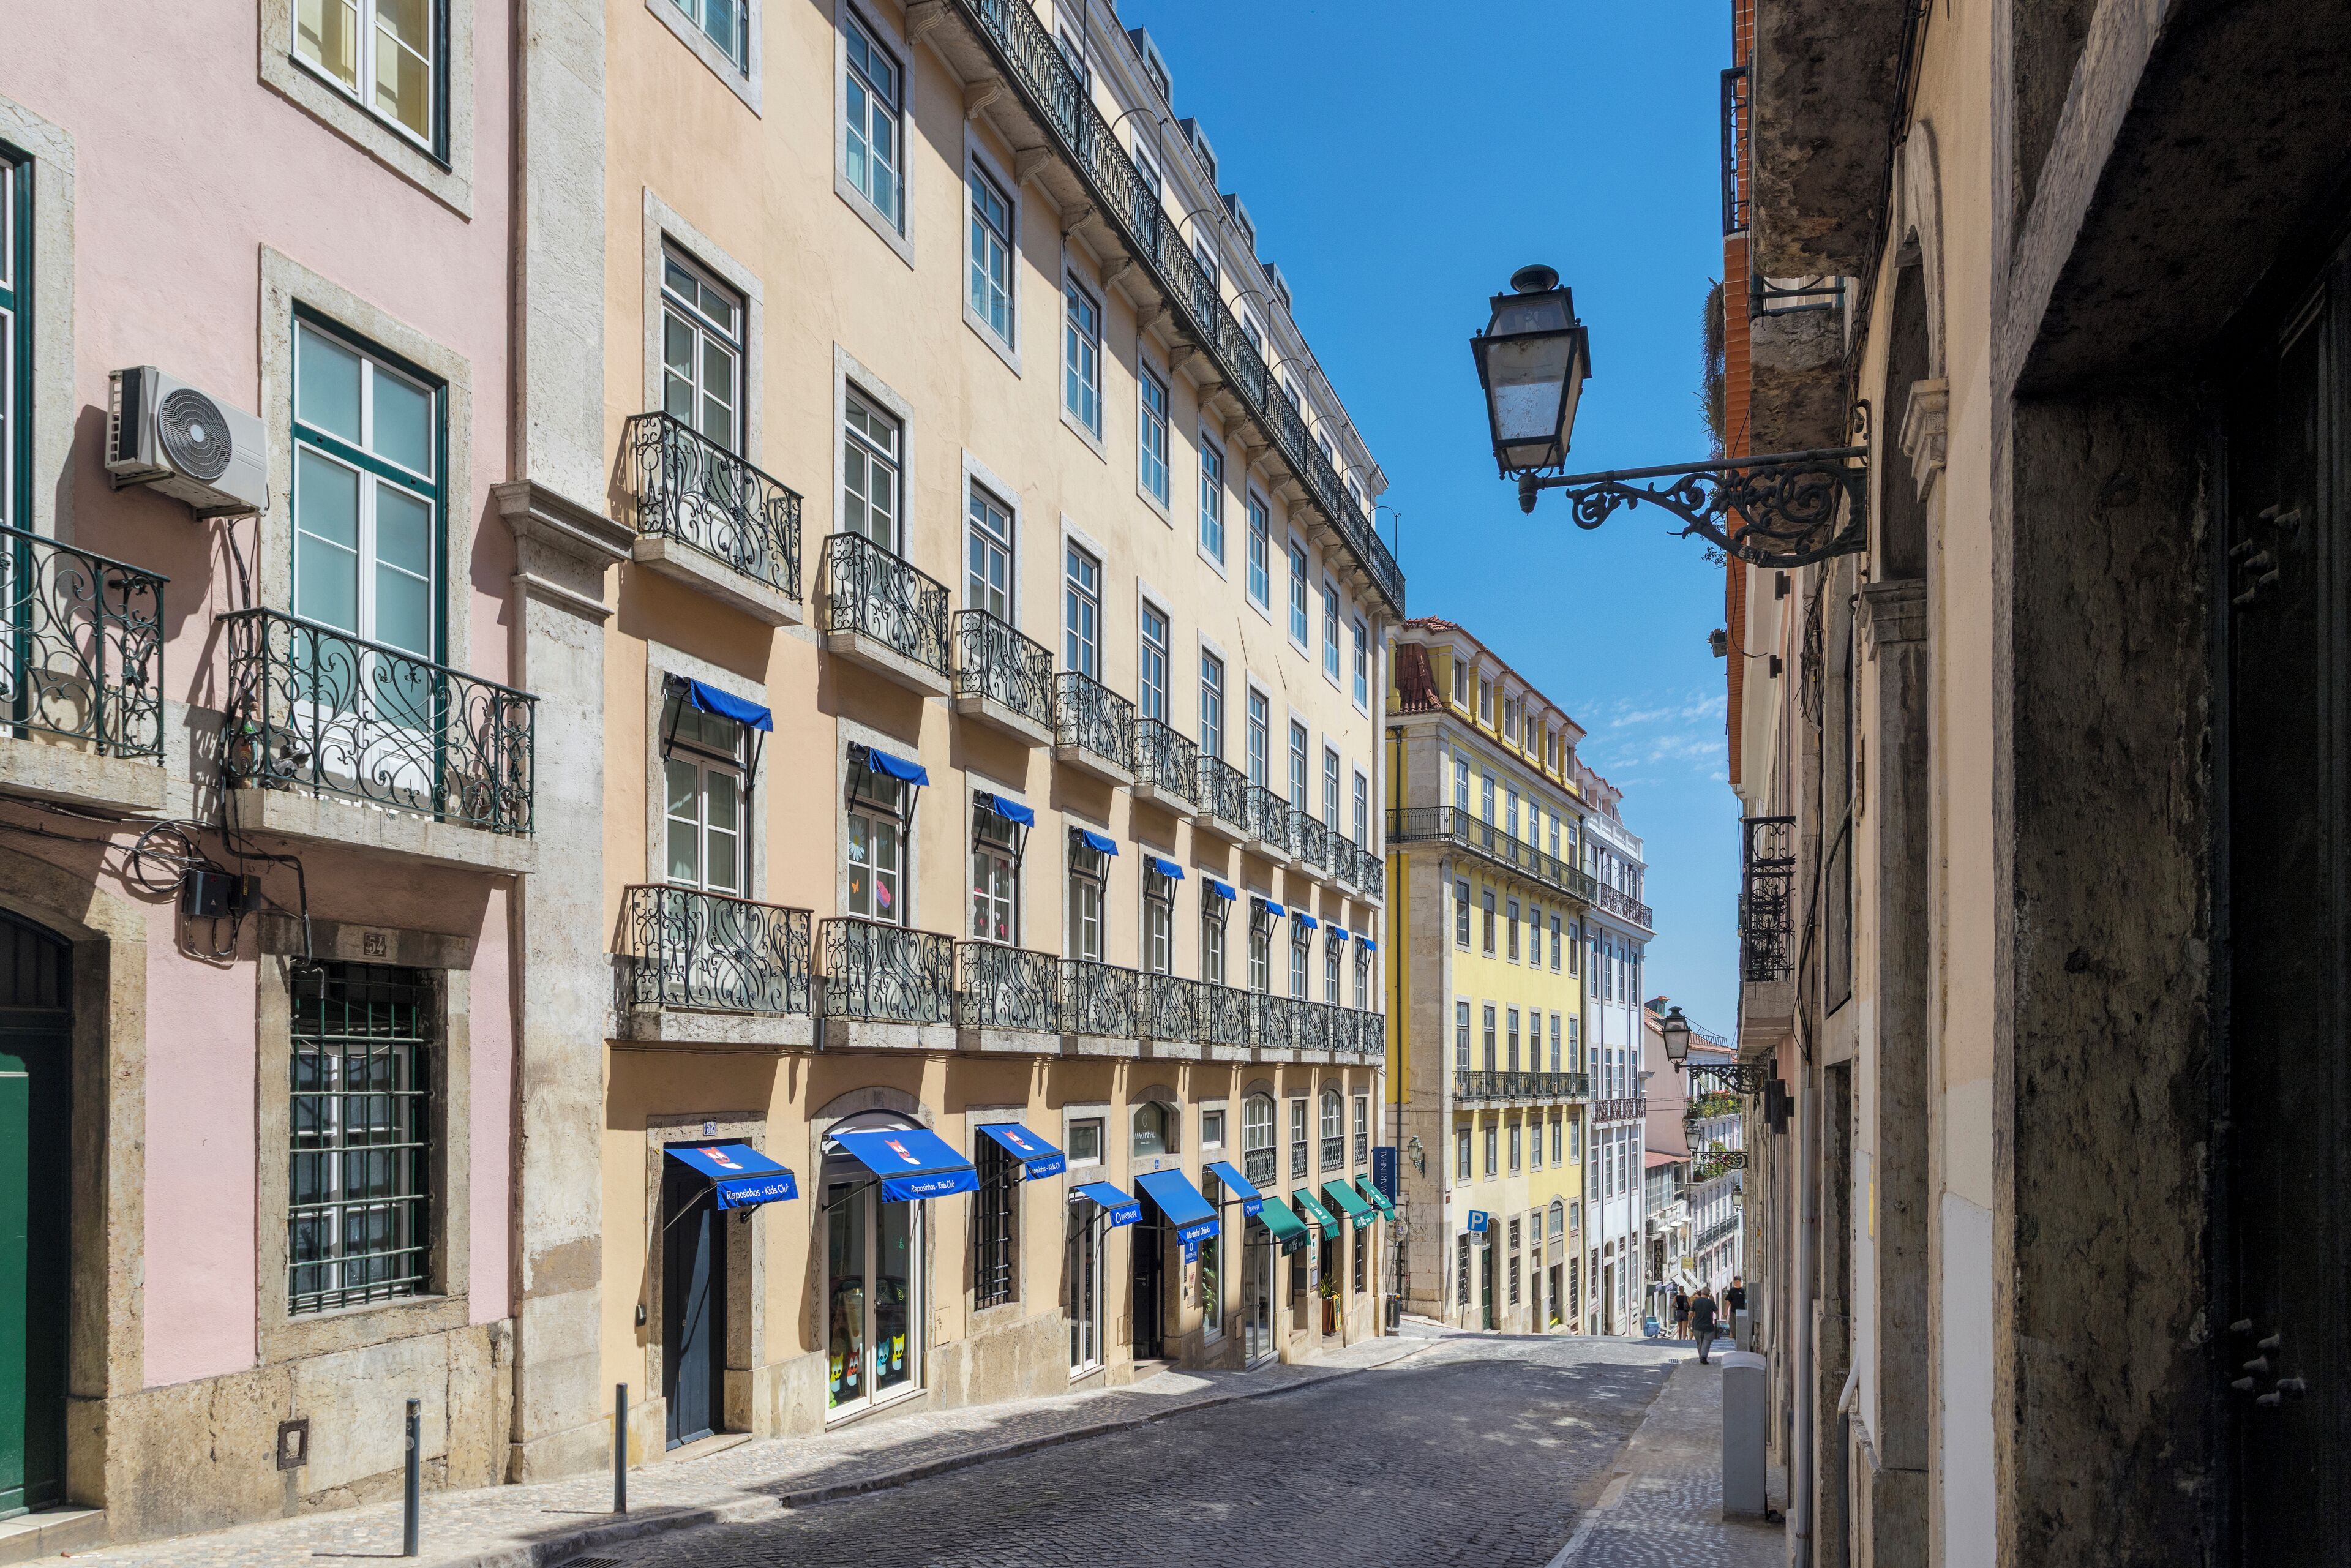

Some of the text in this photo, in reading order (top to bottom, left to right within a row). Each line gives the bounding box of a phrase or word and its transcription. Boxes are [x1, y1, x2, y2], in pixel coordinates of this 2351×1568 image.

[365, 936, 385, 955] 54
[707, 1121, 715, 1134] 52
[726, 1188, 760, 1201] Raposinhos
[764, 1185, 778, 1195] Kids
[910, 1182, 936, 1194] Raposinhos
[937, 1180, 947, 1189] Kids
[1187, 1225, 1210, 1239] Martinhal Chiado
